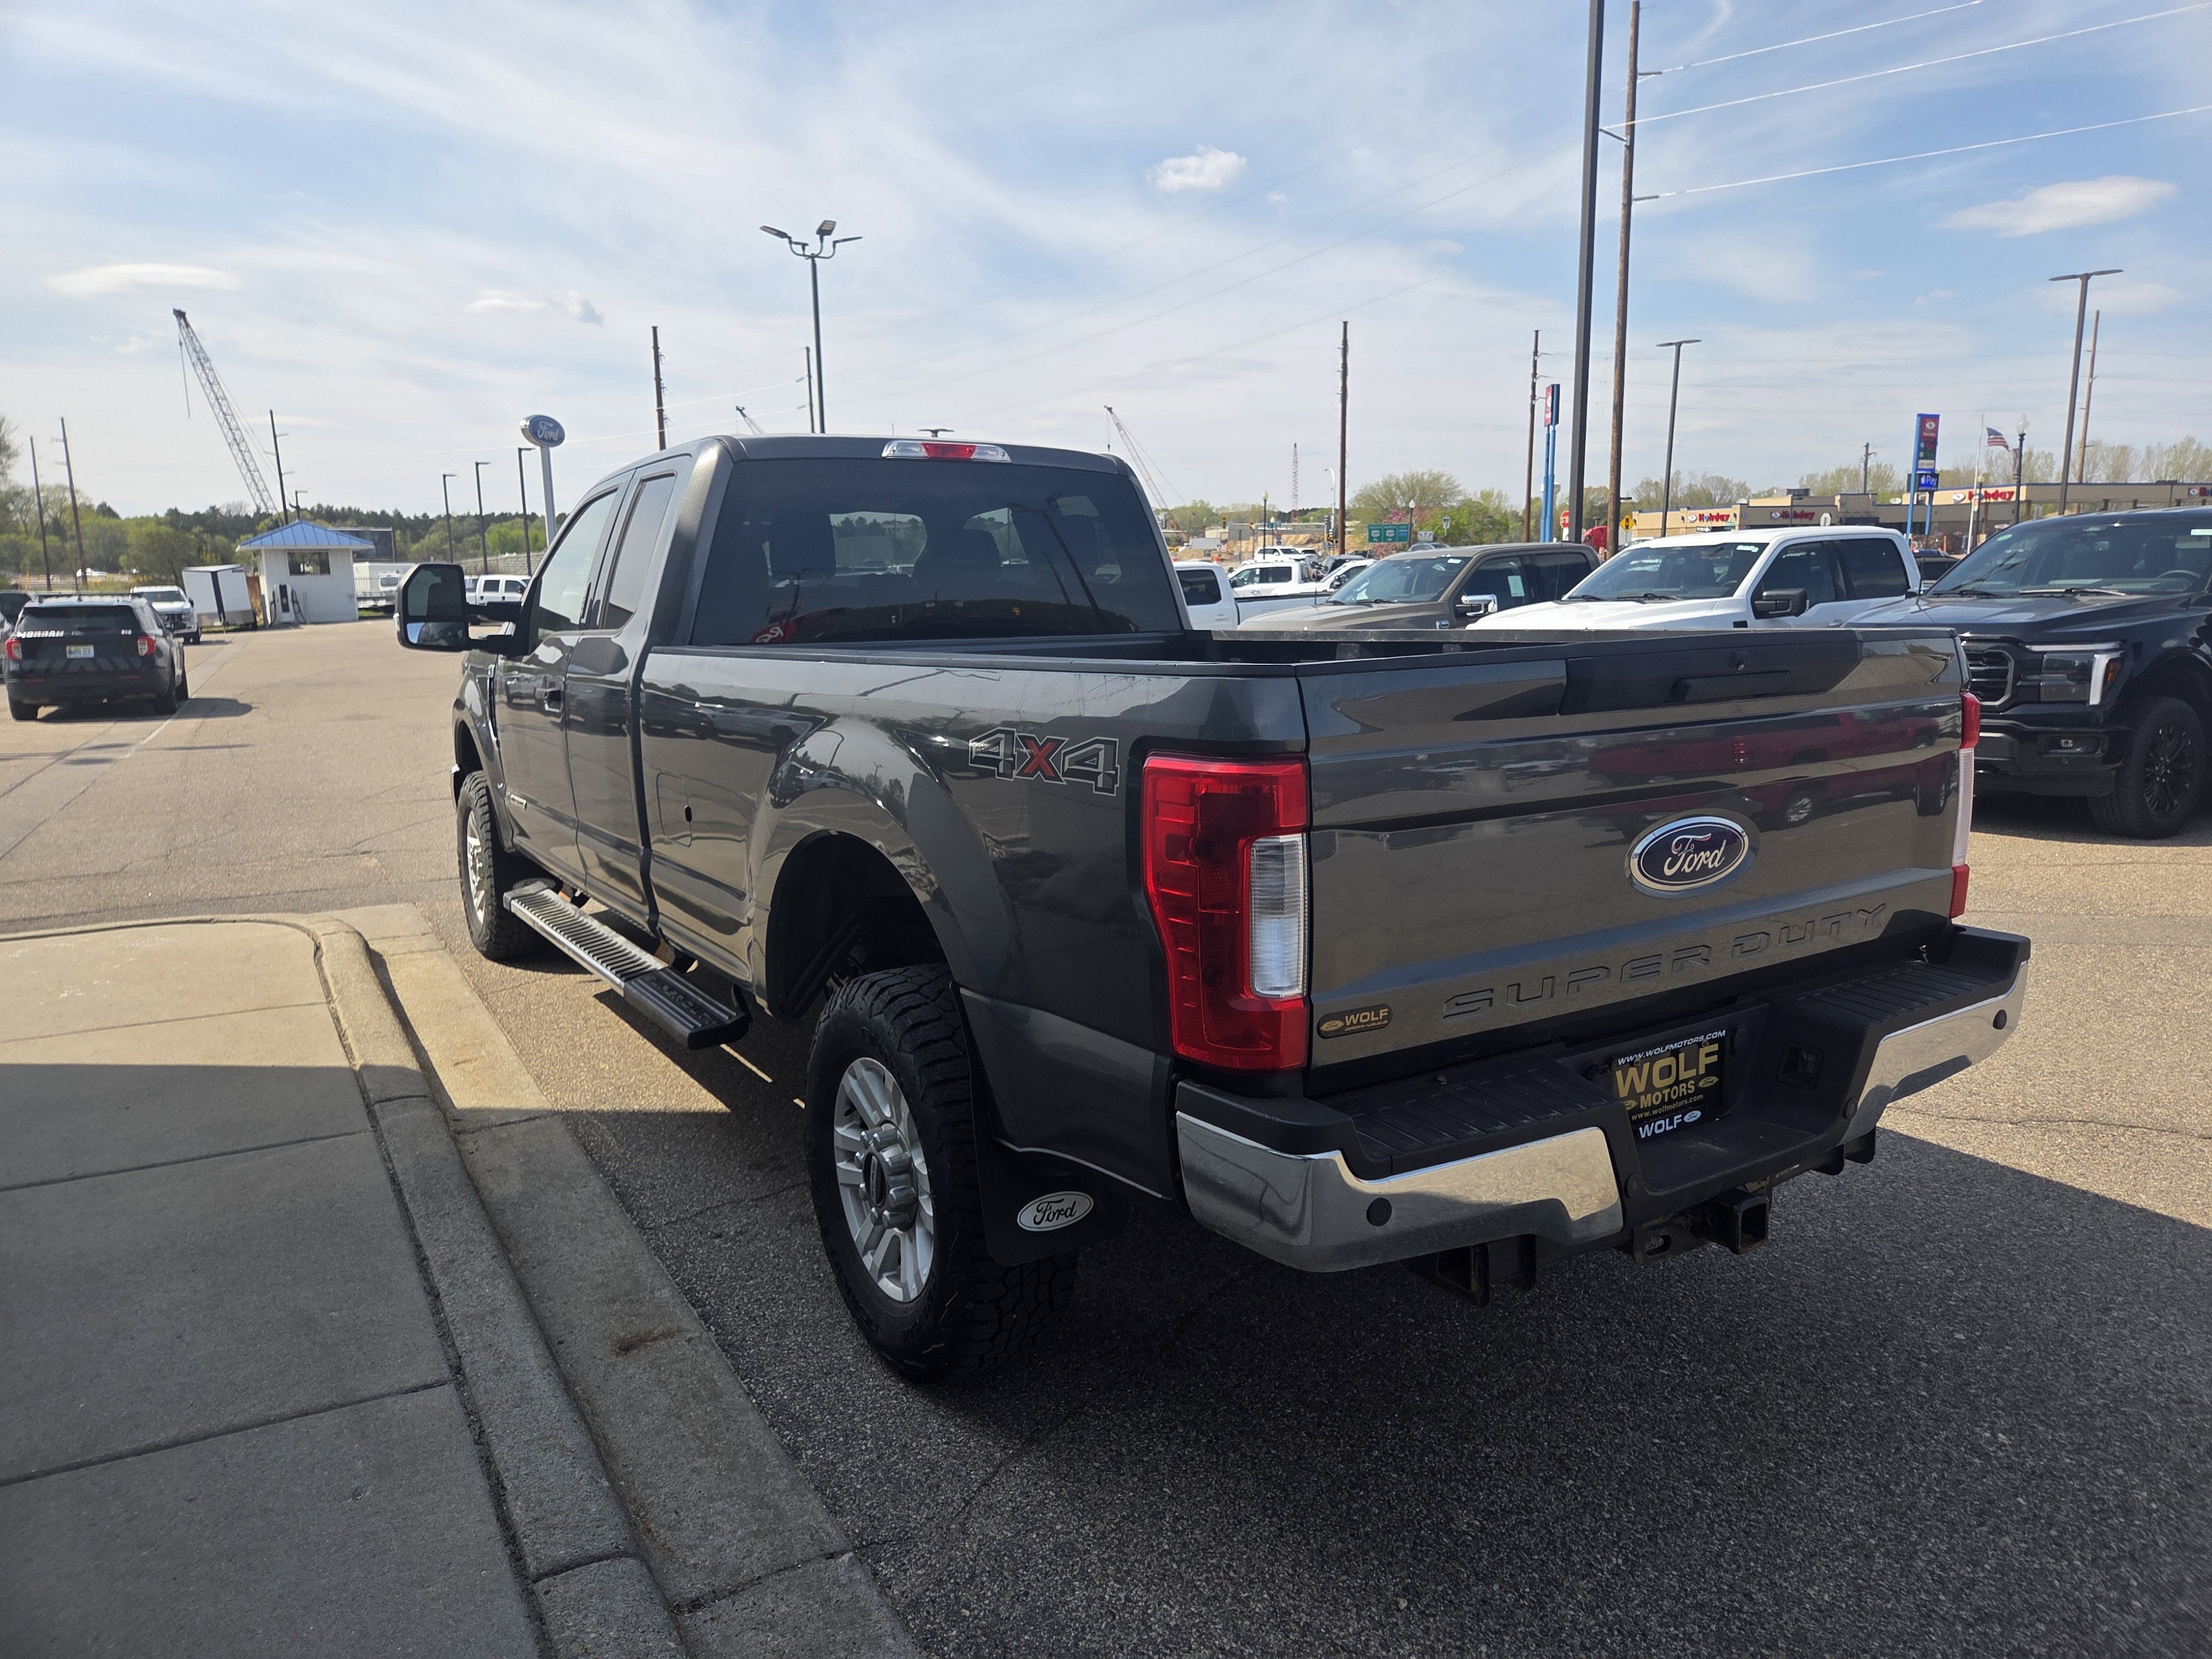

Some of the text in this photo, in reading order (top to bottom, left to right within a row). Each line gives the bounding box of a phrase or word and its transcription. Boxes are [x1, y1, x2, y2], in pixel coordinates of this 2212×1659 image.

[537, 420, 559, 441] Ford
[1699, 513, 1730, 523] Holiday
[1663, 833, 1727, 877] Ford
[1442, 902, 1887, 1021] SUPER DUTY
[1345, 1008, 1389, 1026] WOLF
[1618, 1030, 1726, 1066] WWW.WOLFMOTORS.COM
[1615, 1043, 1719, 1098] WOLF
[1631, 1094, 1703, 1121] www.wolfmotors.com
[1640, 1080, 1695, 1109] MOTORS
[1639, 1114, 1682, 1139] WOLF
[1033, 1198, 1077, 1225] Ford
